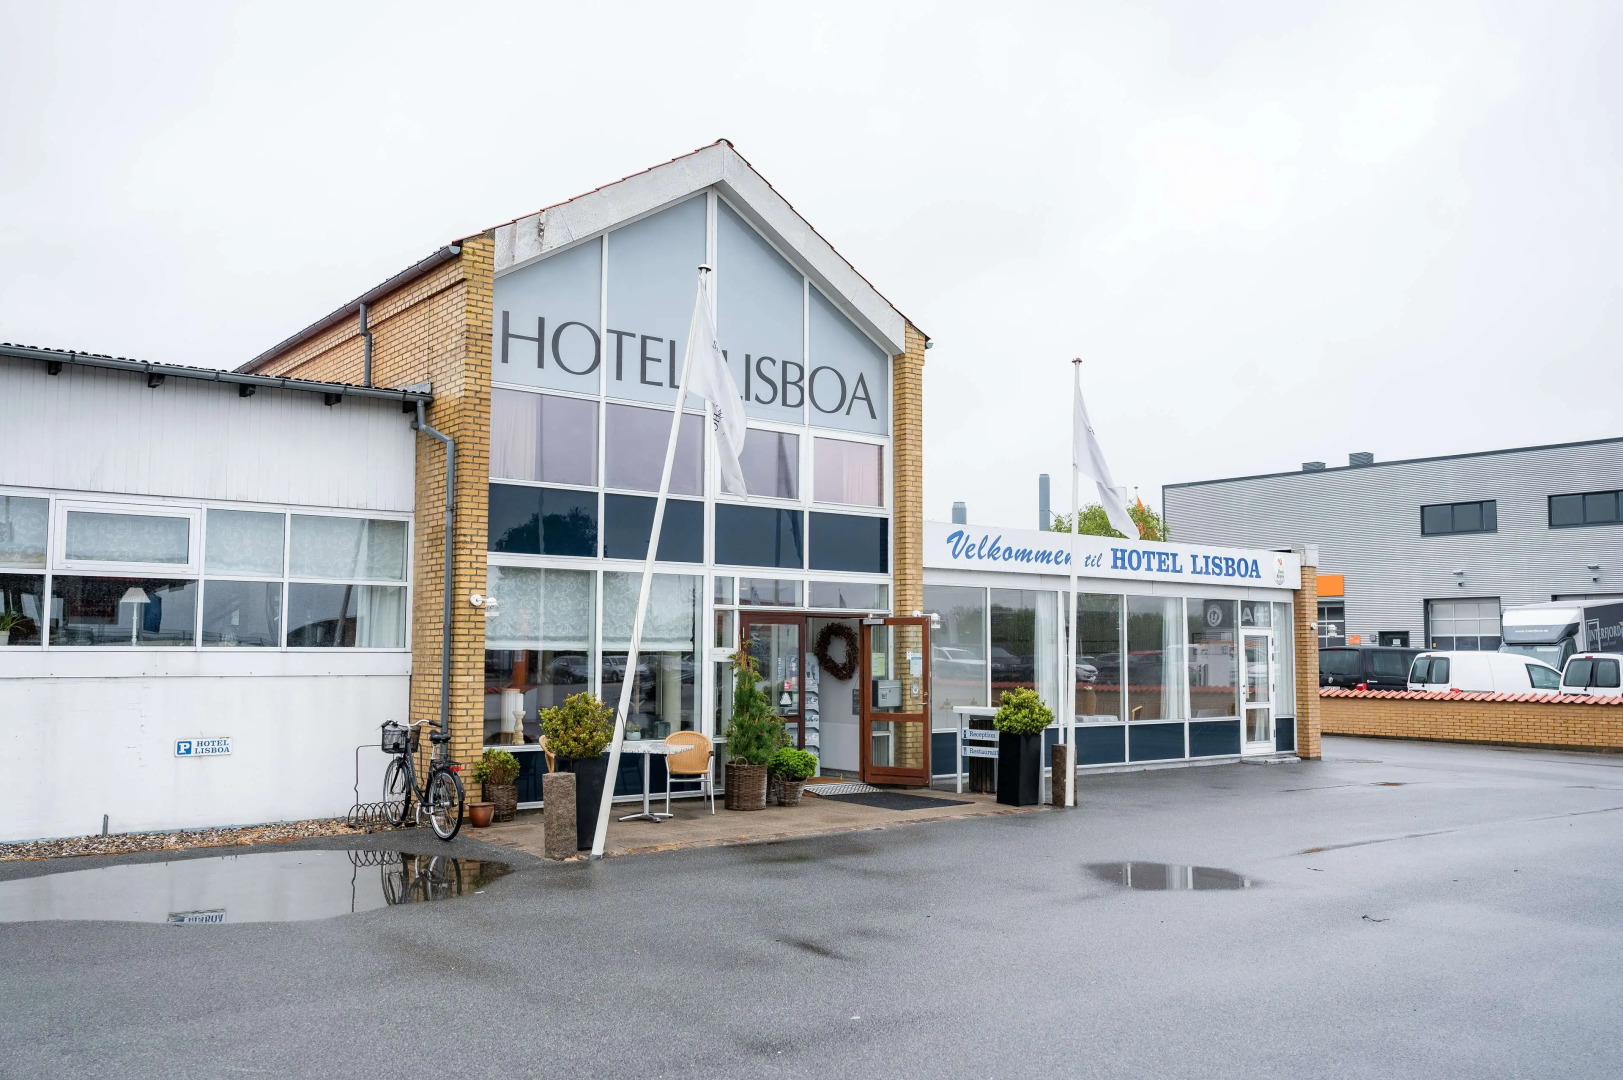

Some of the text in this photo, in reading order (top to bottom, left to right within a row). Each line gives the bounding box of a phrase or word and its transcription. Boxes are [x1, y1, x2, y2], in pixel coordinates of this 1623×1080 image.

[501, 310, 877, 420] HOTEL ISBOA
[1084, 552, 1103, 568] til
[1110, 547, 1184, 574] HOTEL
[1190, 554, 1262, 579] LISBOA
[969, 731, 996, 739] Reception
[178, 742, 191, 754] P
